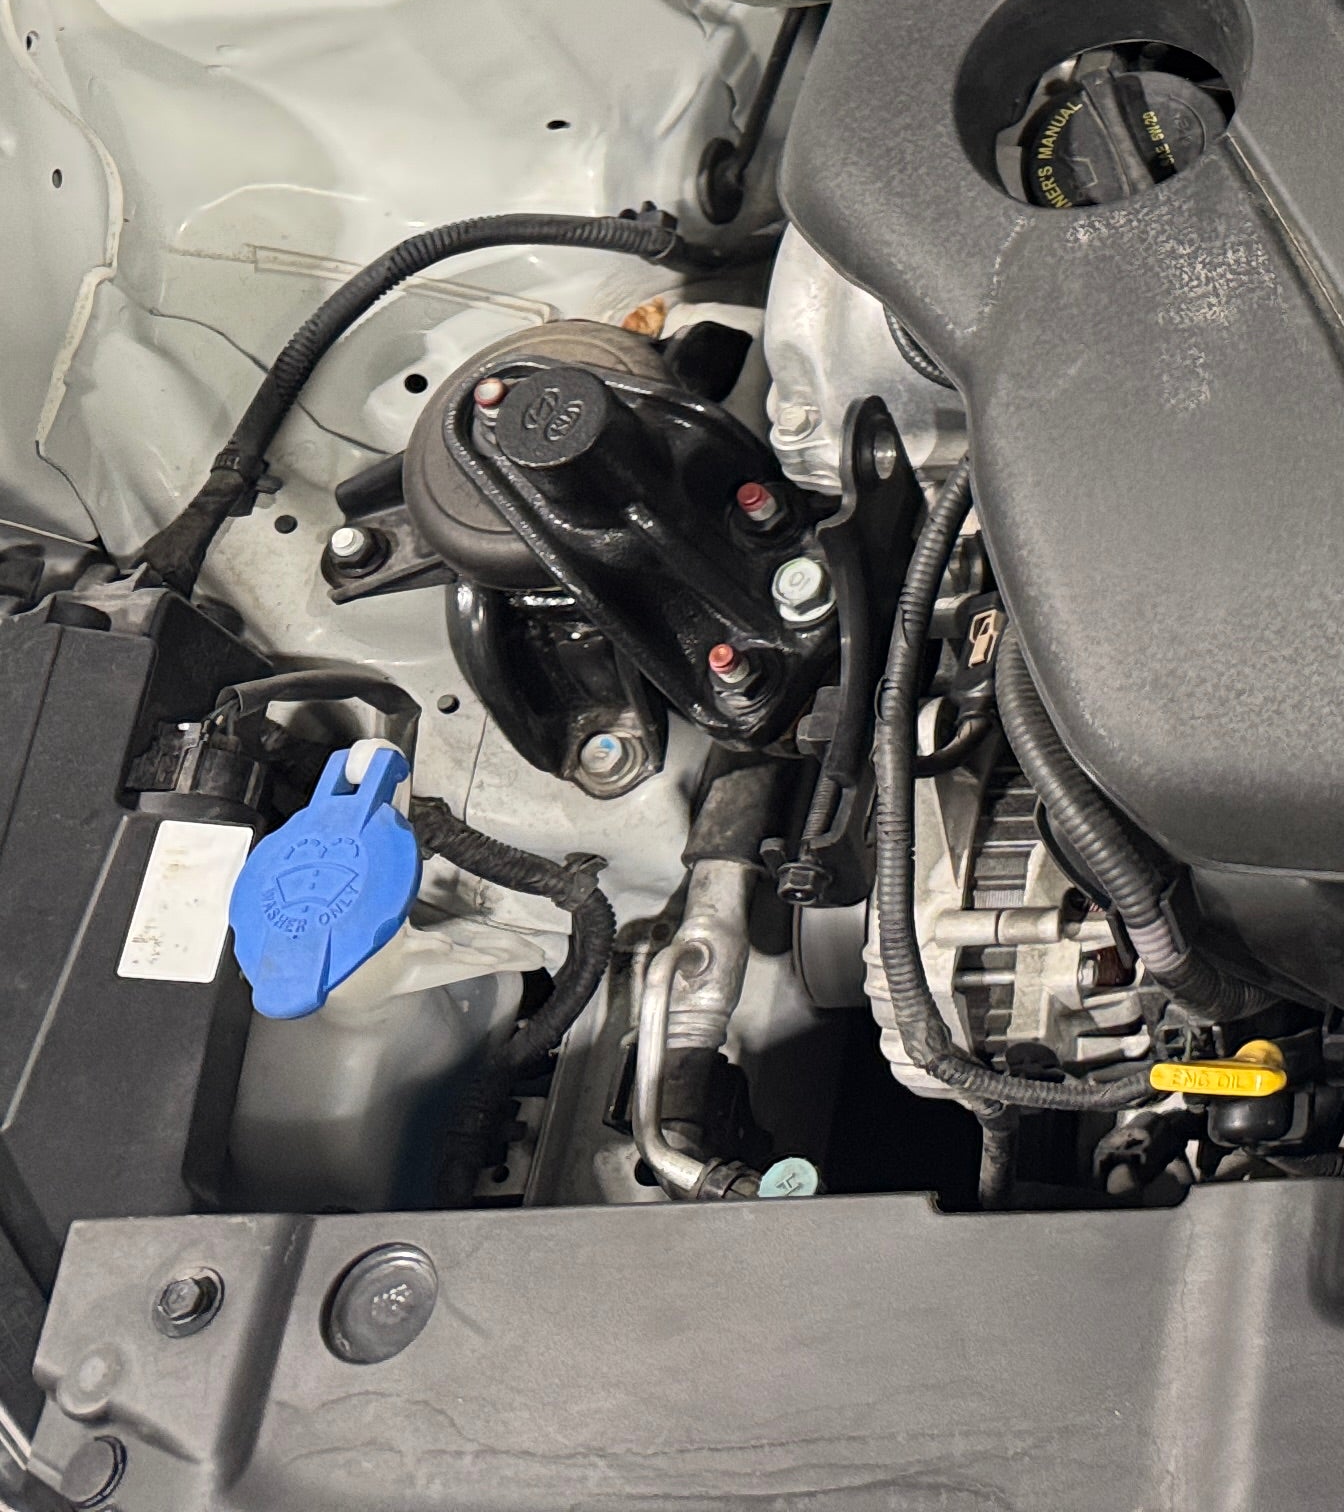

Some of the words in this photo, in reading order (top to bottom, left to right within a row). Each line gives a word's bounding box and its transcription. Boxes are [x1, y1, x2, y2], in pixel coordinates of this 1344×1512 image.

[1037, 101, 1083, 159] MANUAL
[261, 888, 308, 933] WASHER
[318, 883, 359, 926] ONLY
[1172, 1068, 1210, 1087] ENG
[1218, 1073, 1244, 1089] OIL
